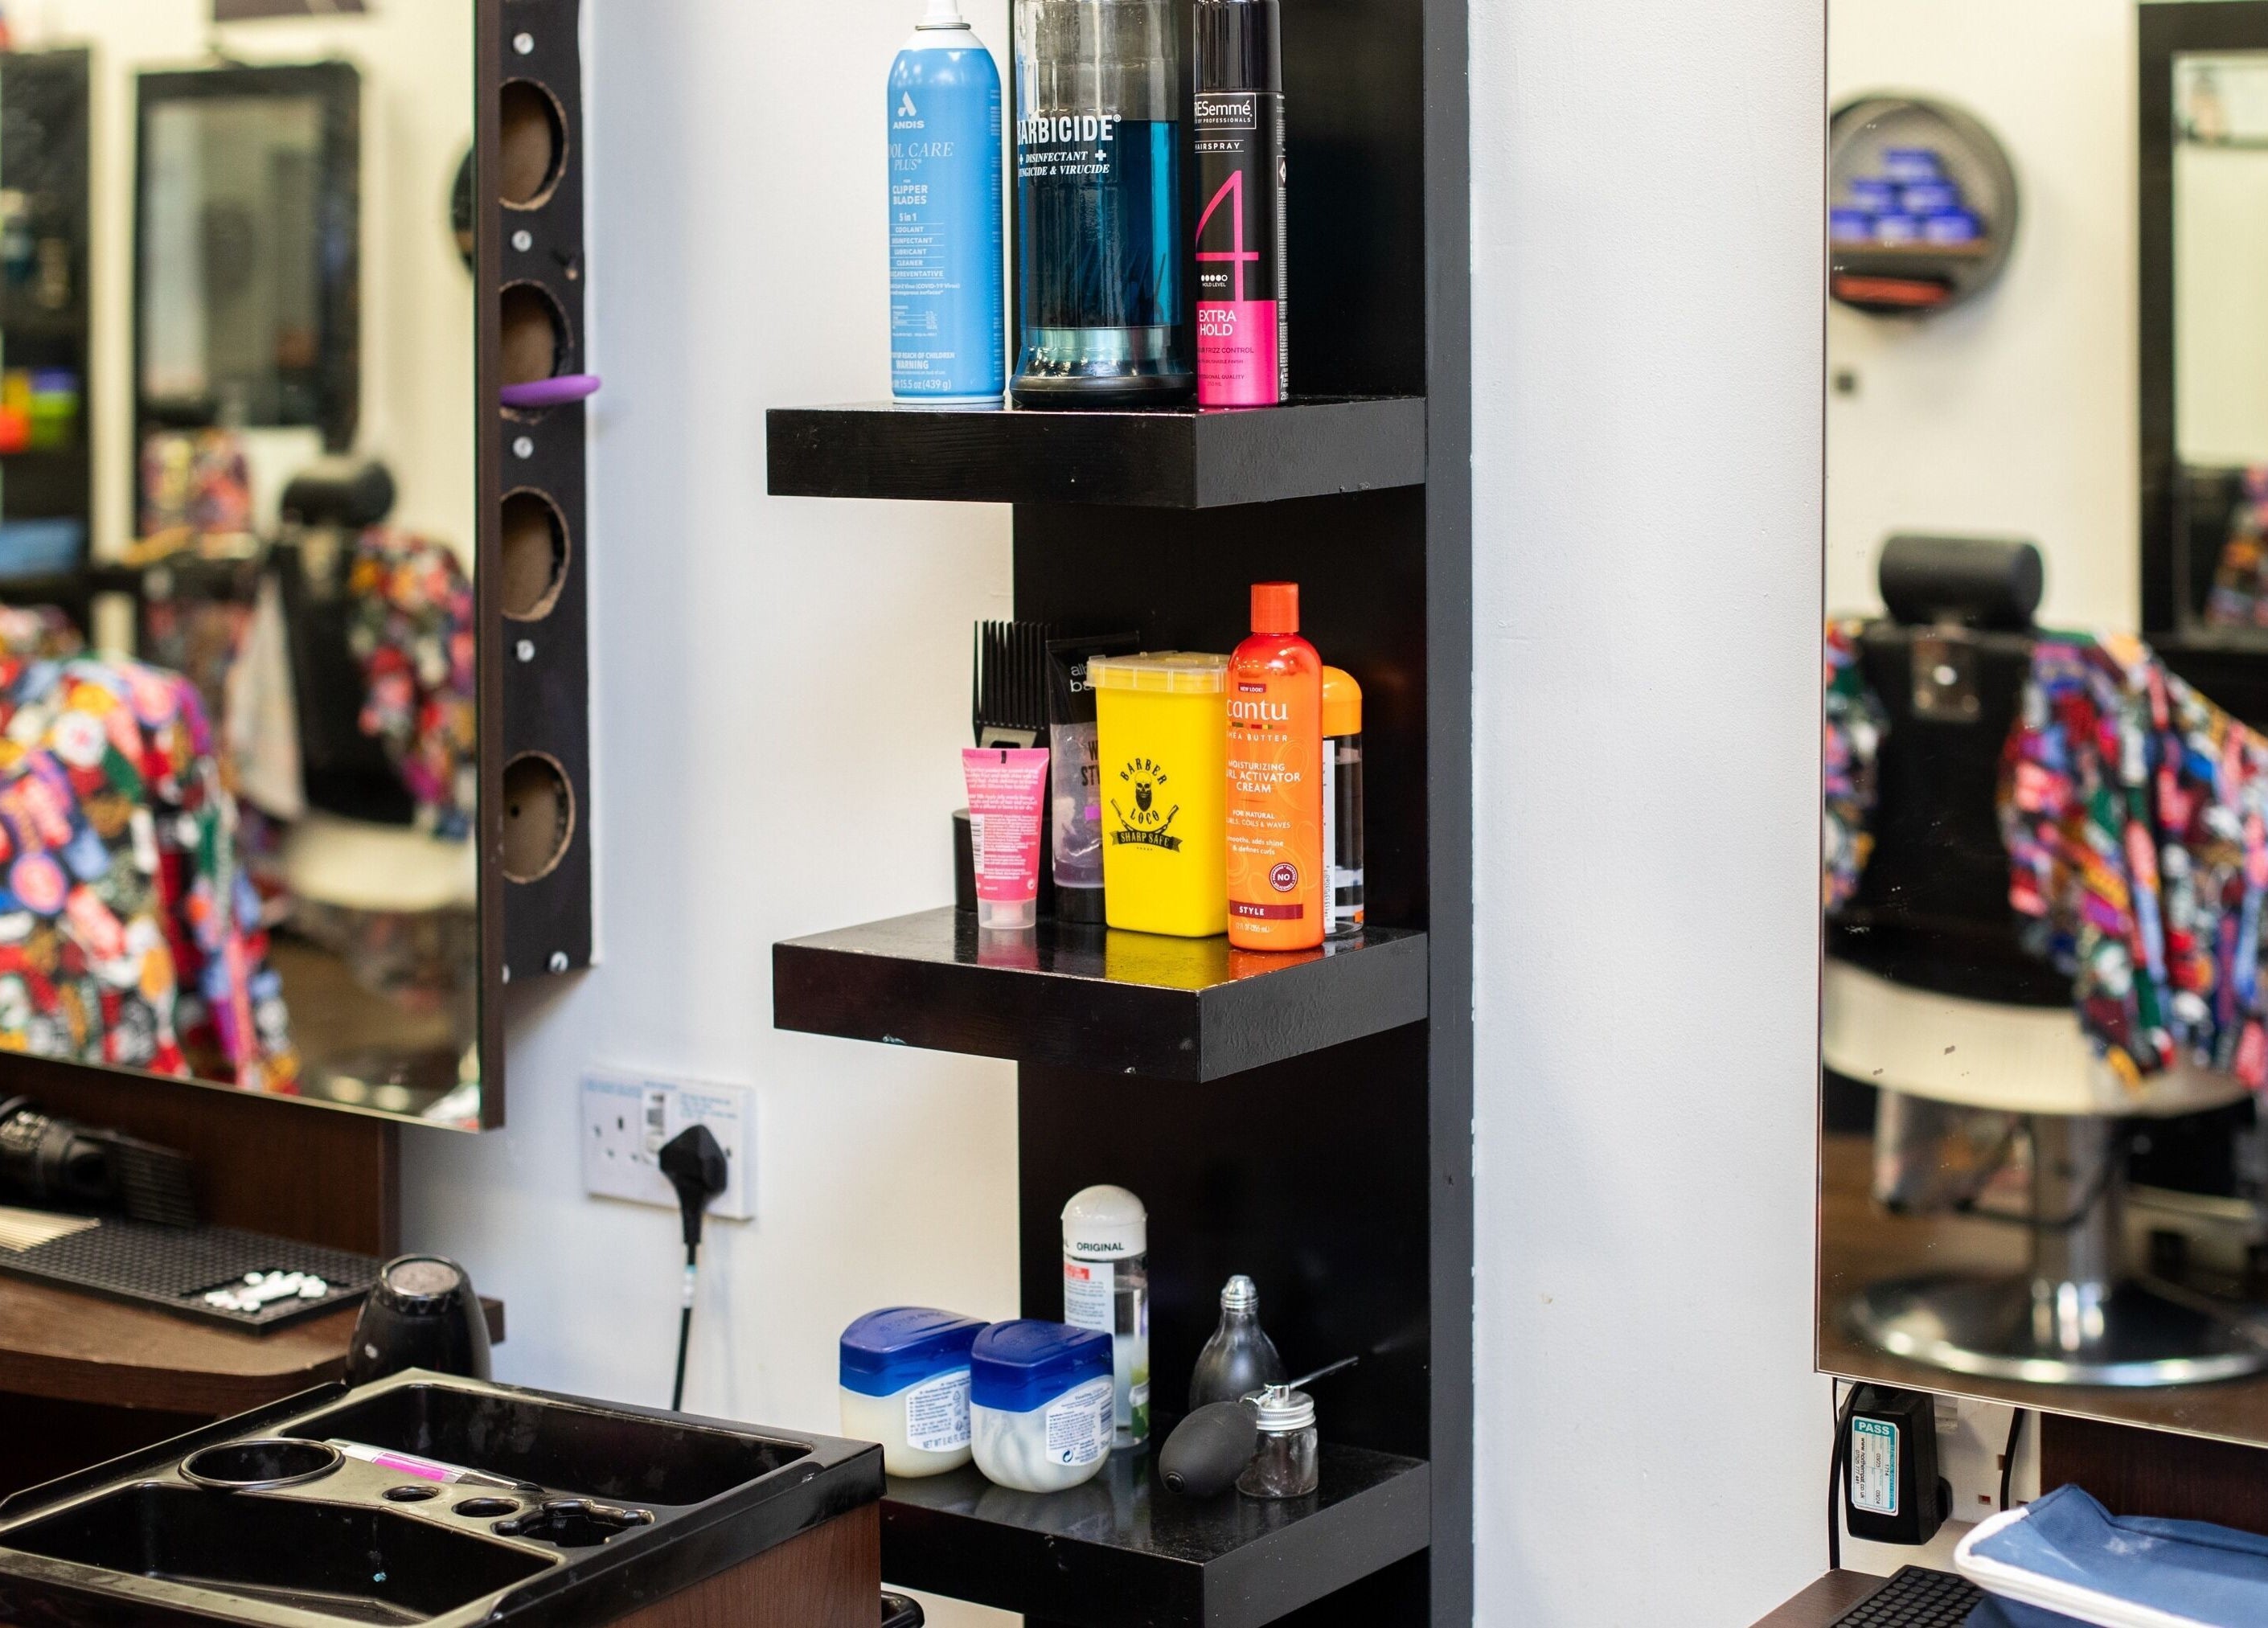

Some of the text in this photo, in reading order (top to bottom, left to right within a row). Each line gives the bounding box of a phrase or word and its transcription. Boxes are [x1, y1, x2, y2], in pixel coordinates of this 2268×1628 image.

[1194, 100, 1251, 117] RESemmé
[892, 121, 925, 129] ANDIS
[908, 141, 954, 157] CARE
[1026, 151, 1088, 163] DISINFECTANT
[1050, 166, 1057, 175] &
[1060, 164, 1109, 174] VIRUCIDE
[892, 185, 928, 194] CLIPPER
[893, 195, 927, 205] BLADES
[899, 212, 917, 222] 5 in 1
[1196, 170, 1259, 303] 4
[1199, 310, 1237, 322] EXTRA
[1200, 323, 1233, 336] HOLD
[896, 360, 929, 369] WARNING
[922, 379, 941, 390] (439
[942, 379, 952, 391] g)
[1227, 699, 1289, 721] cantu
[1227, 731, 1288, 742] HEA BUTTER
[1120, 757, 1167, 785] BARBER
[1228, 760, 1286, 772] MOISTURIZING
[1239, 771, 1302, 782] ACTIVATOR
[1237, 781, 1271, 793] CREAM
[1130, 808, 1160, 825] LOCO
[1245, 810, 1275, 820] NATURAL
[1242, 818, 1259, 827] COILS
[1121, 831, 1170, 847] SHARP SAFE
[1265, 839, 1284, 847] shine
[1238, 845, 1260, 854] defines
[1277, 873, 1290, 881] NO
[1239, 905, 1265, 916] STYLE
[1077, 1242, 1124, 1252] ORIGINAL
[1858, 1421, 1890, 1435] PASS
